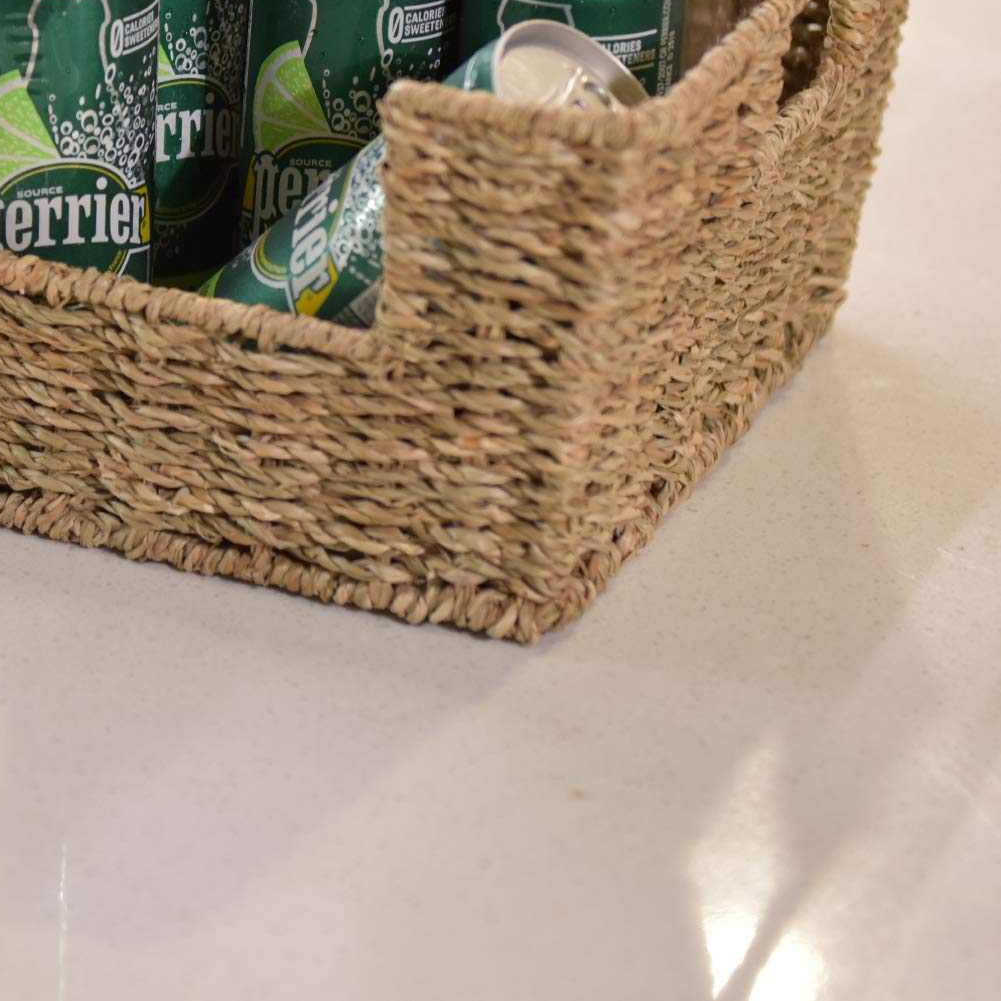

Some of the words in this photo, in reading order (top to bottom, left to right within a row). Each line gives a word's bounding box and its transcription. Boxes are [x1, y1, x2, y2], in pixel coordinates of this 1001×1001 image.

[124, 10, 155, 36] CALORIES
[404, 18, 446, 37] SWEETEN
[600, 39, 642, 55] ALORIES
[158, 101, 178, 111] RCE
[155, 92, 240, 163] rrier
[290, 157, 332, 168] SOURCE
[16, 185, 63, 199] SOURCE
